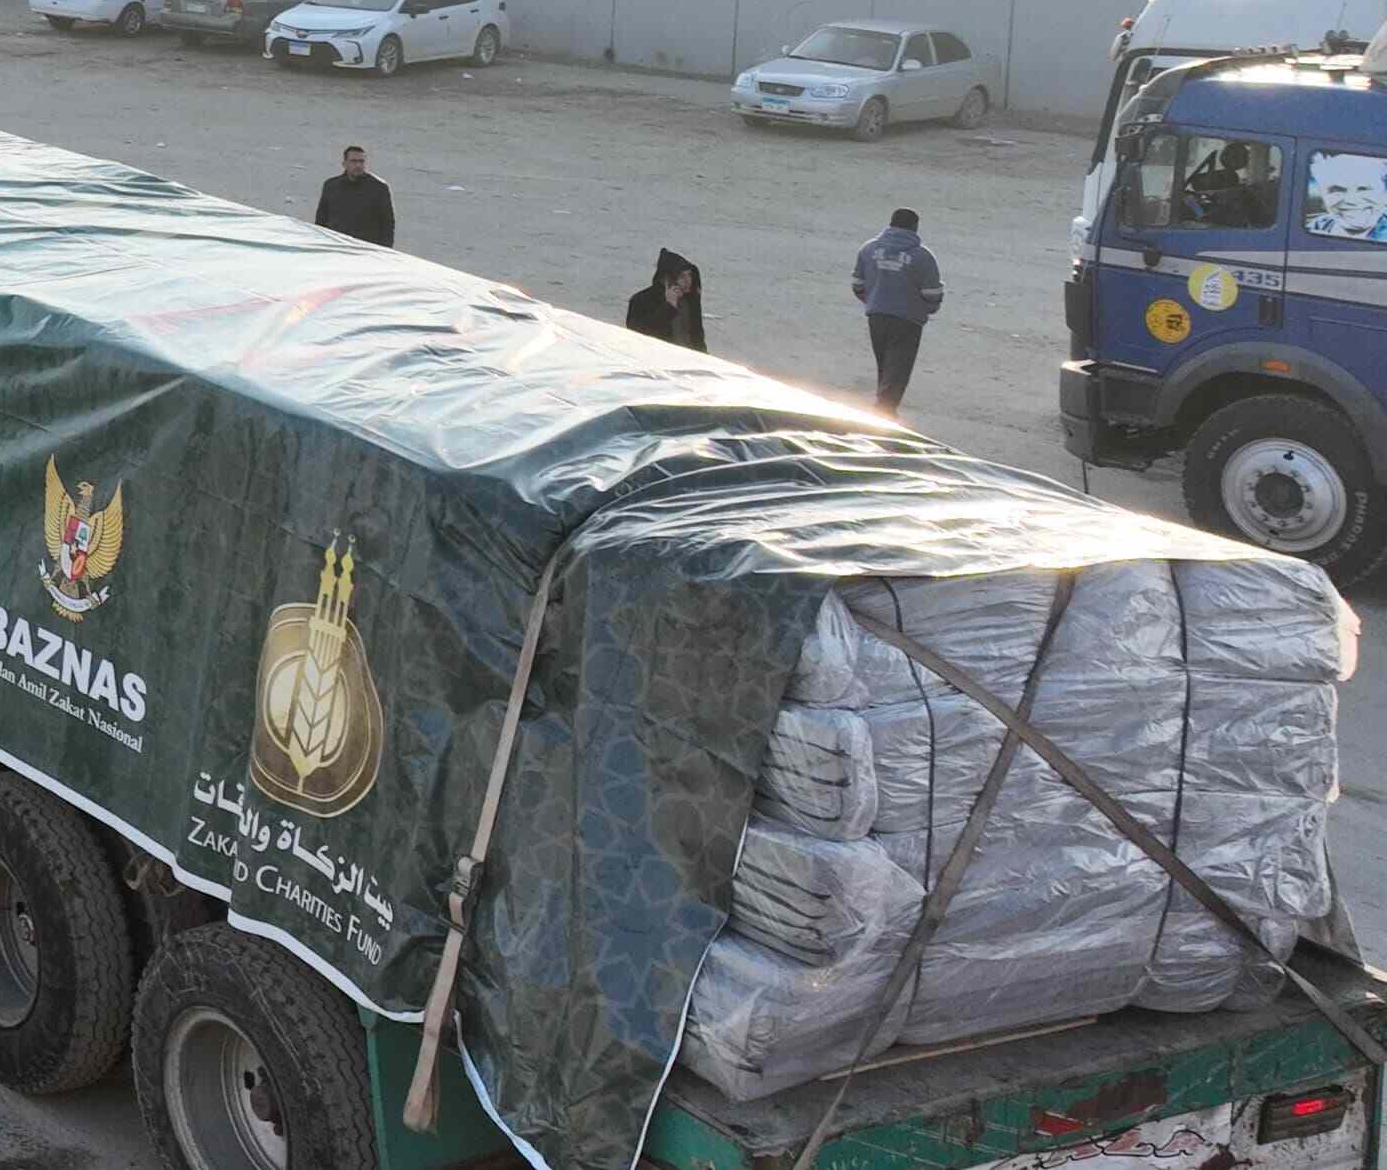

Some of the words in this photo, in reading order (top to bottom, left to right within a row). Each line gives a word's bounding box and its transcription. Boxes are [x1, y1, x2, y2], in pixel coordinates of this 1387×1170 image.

[17, 672, 48, 703] Amil
[48, 686, 86, 722] Zakat
[87, 707, 144, 755] Nasional
[186, 815, 238, 858] ZAKA
[254, 864, 343, 935] CHARITIES
[345, 913, 383, 967] FUND
[275, 818, 364, 896] الزكاة
[363, 875, 394, 931] بيت
